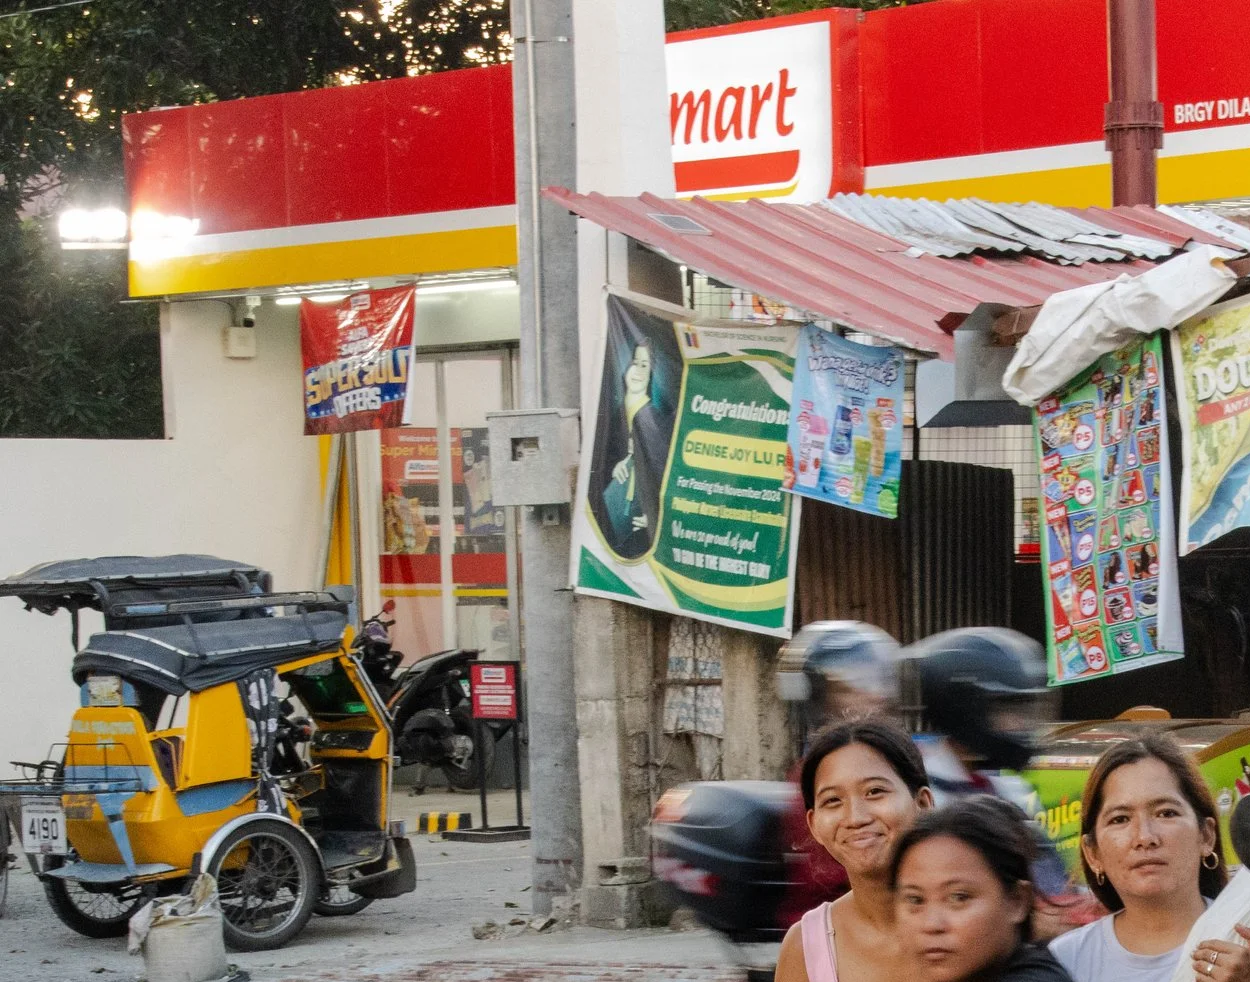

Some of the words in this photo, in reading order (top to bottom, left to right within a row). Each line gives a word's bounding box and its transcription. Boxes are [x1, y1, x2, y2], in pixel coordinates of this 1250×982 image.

[669, 67, 797, 146] mart
[1173, 103, 1214, 125] BRGY
[684, 440, 728, 459] DENISE
[729, 447, 751, 464] JOY
[28, 817, 59, 840] 4190
